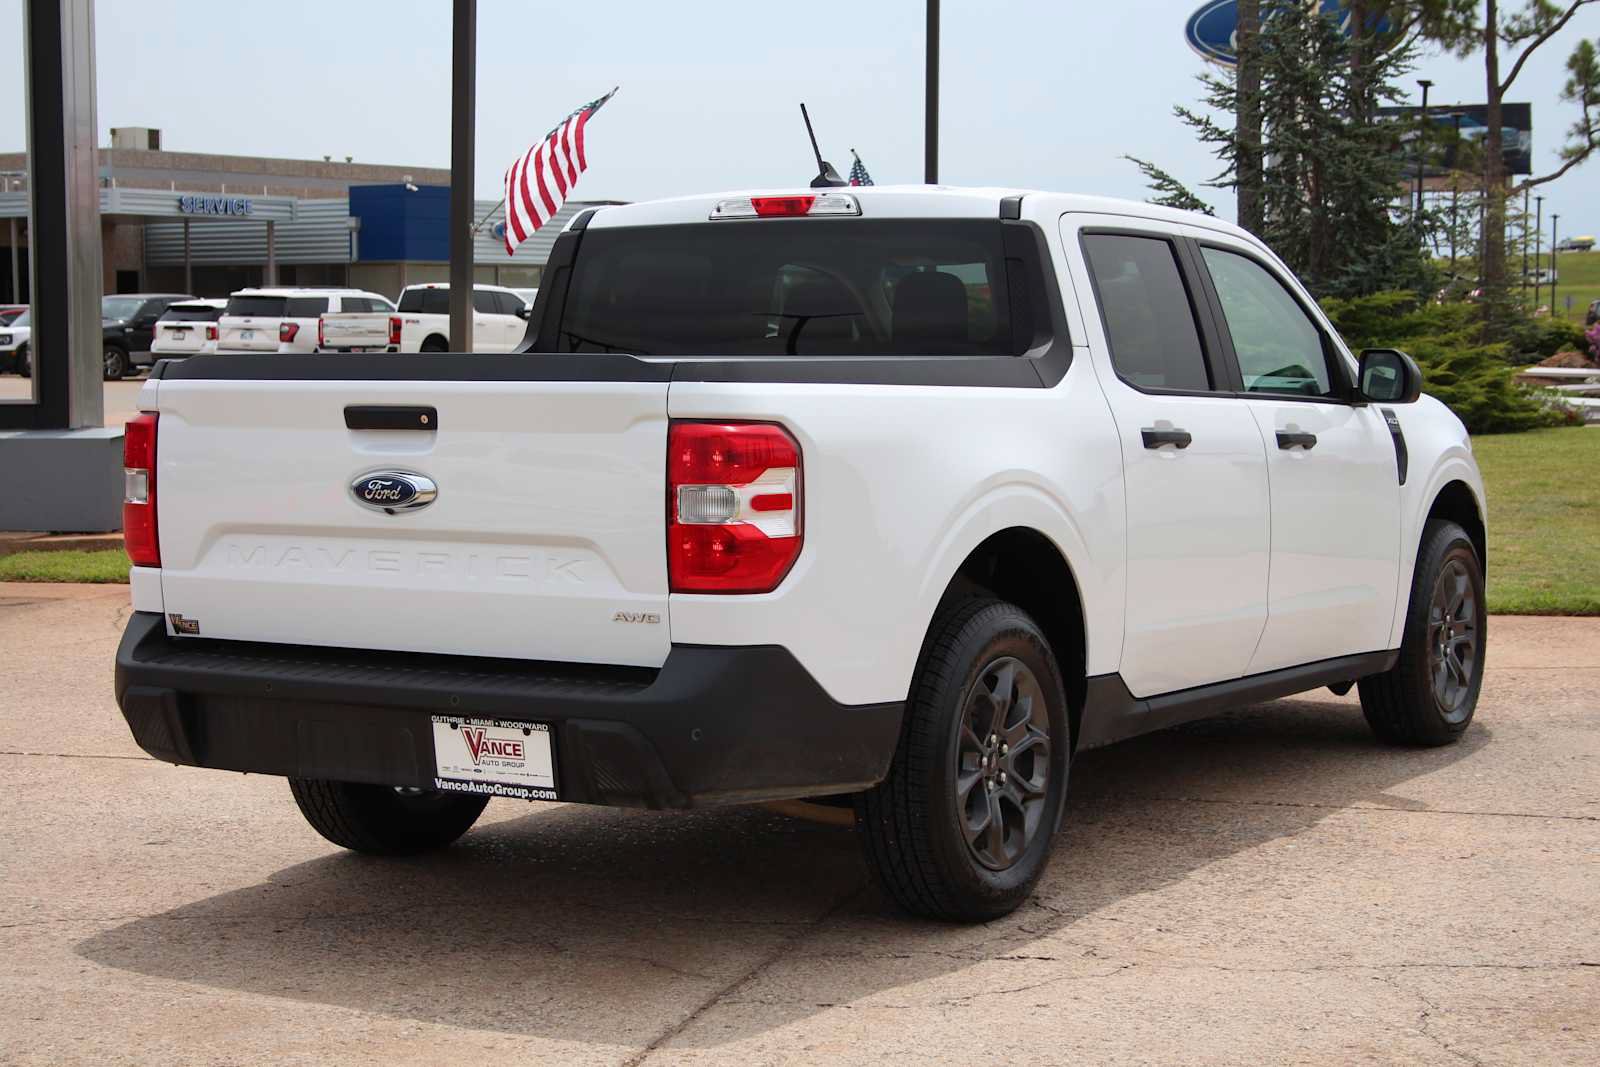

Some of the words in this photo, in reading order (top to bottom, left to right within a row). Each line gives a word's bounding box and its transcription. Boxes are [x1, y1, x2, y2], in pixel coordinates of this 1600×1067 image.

[180, 194, 256, 216] SERVICE
[364, 479, 402, 500] Ford
[227, 544, 585, 583] MAVERICK
[431, 715, 465, 725] GUTHRIE
[470, 719, 494, 727] MIAMI
[499, 720, 548, 730] WOODWARD
[482, 759, 500, 767] AUTO
[501, 760, 525, 768] GROUP
[434, 777, 557, 800] VanceAutoGroup.com
